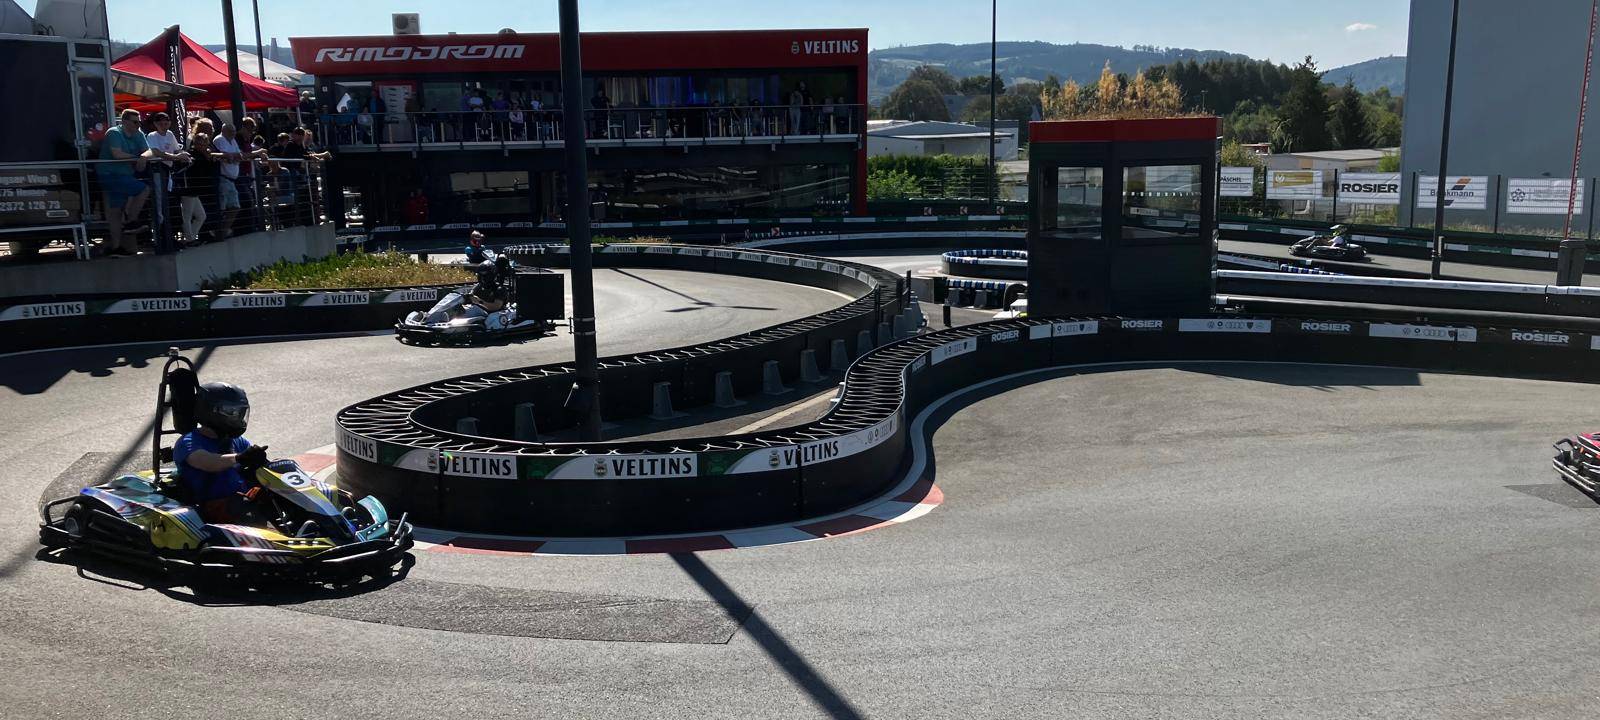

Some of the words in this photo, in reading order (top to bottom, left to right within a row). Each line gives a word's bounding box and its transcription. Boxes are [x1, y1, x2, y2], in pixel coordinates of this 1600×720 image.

[804, 40, 859, 54] VELTINS
[1341, 183, 1399, 193] ROSIER
[1431, 189, 1474, 197] Bkmann
[331, 293, 367, 304] VELTINS
[406, 289, 436, 300] VELTINS
[141, 299, 187, 310] VELTINS
[240, 296, 283, 307] VELTINS
[33, 304, 82, 317] VELTINS
[1121, 319, 1162, 329] ROSIER
[1301, 322, 1350, 332] ROSIER
[991, 330, 1020, 342] ROSIER
[1511, 332, 1569, 343] ROSIER
[611, 457, 692, 476] VELTINS
[287, 474, 305, 486] 3
